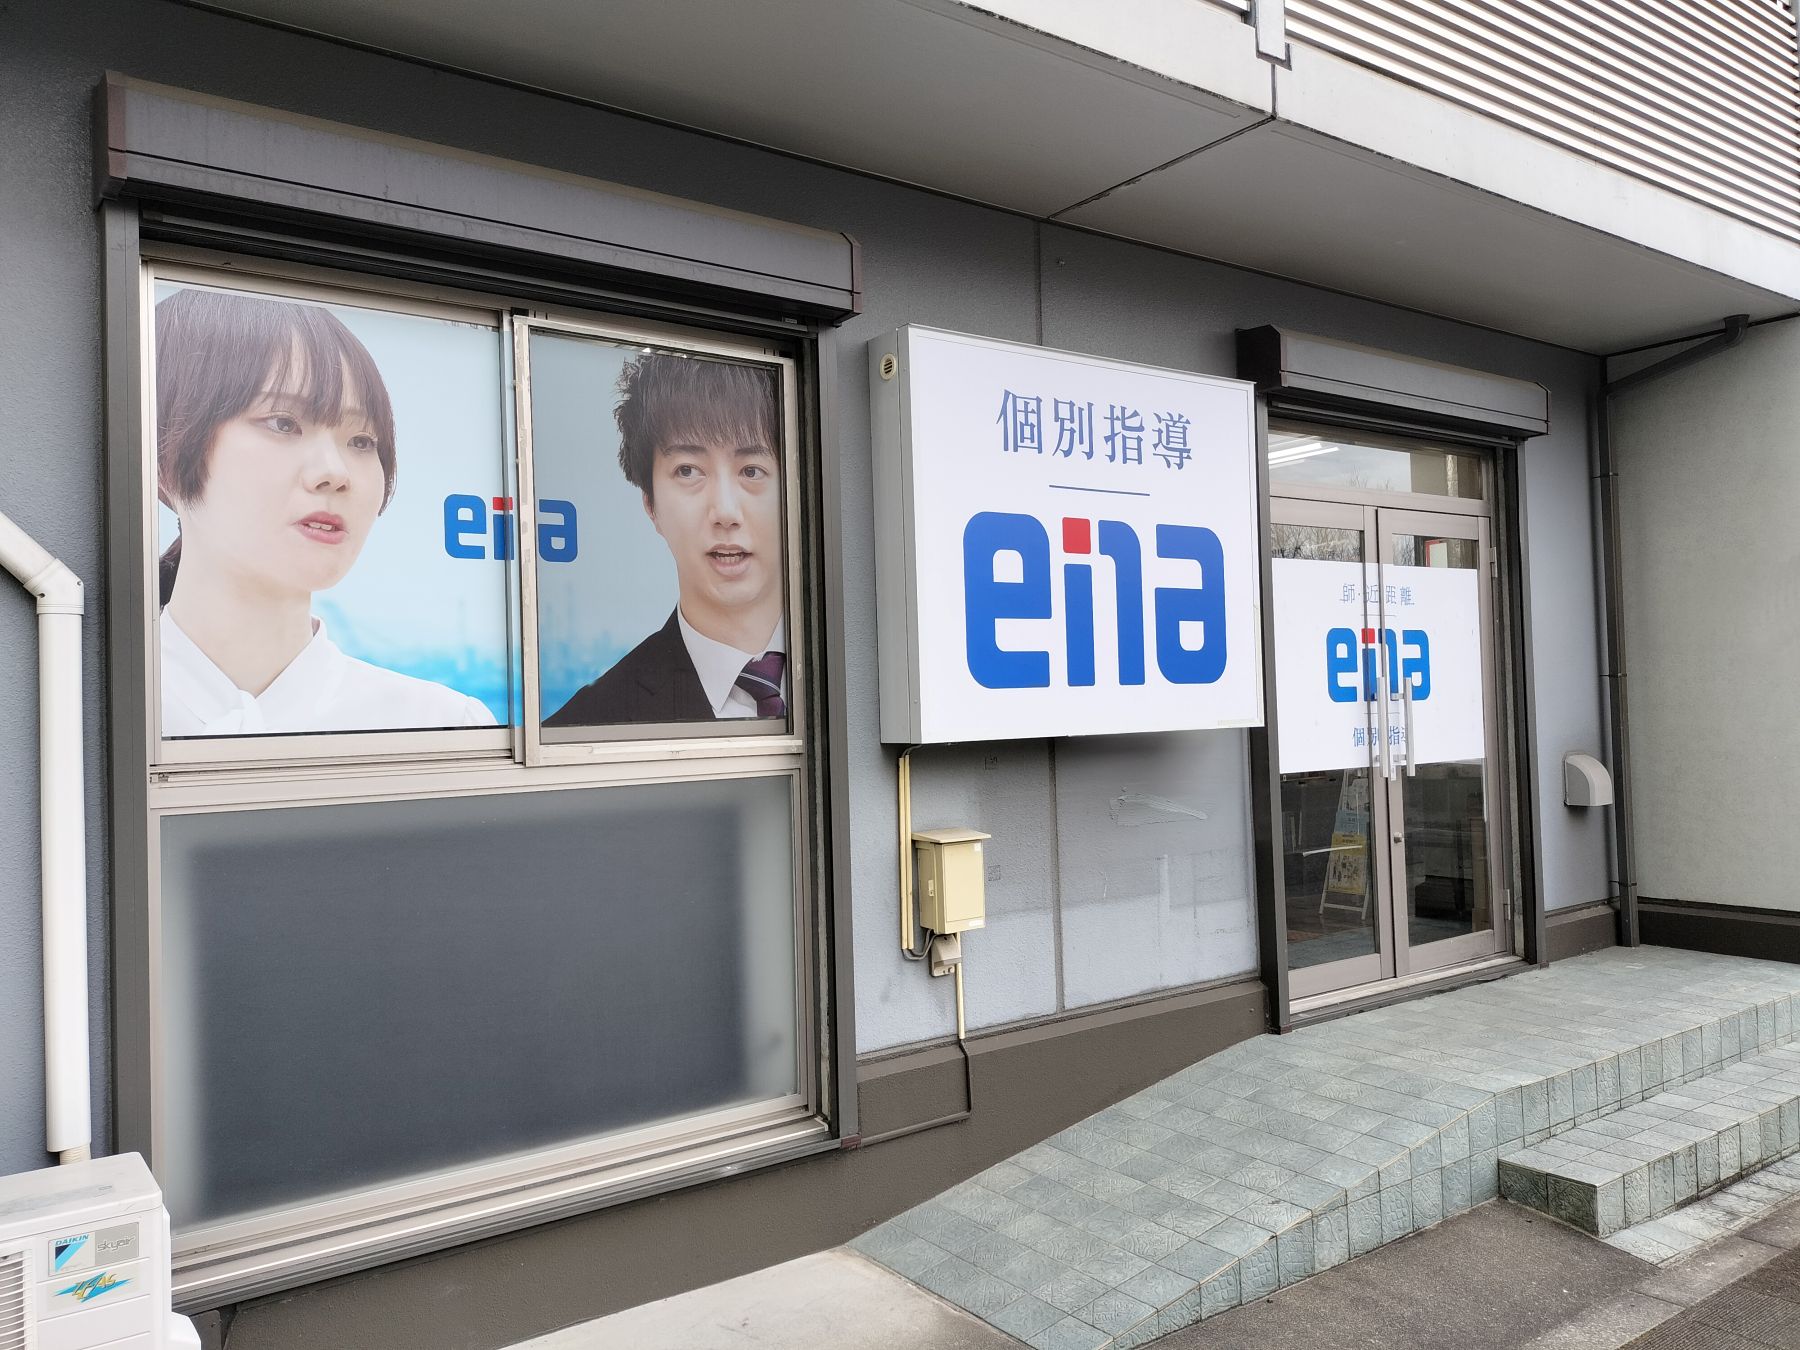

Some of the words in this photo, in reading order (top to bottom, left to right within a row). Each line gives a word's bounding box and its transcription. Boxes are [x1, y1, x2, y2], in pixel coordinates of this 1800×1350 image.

[996, 388, 1193, 470] 個別指導
[963, 511, 1227, 689] ena
[55, 1233, 89, 1246] DAIKIN
